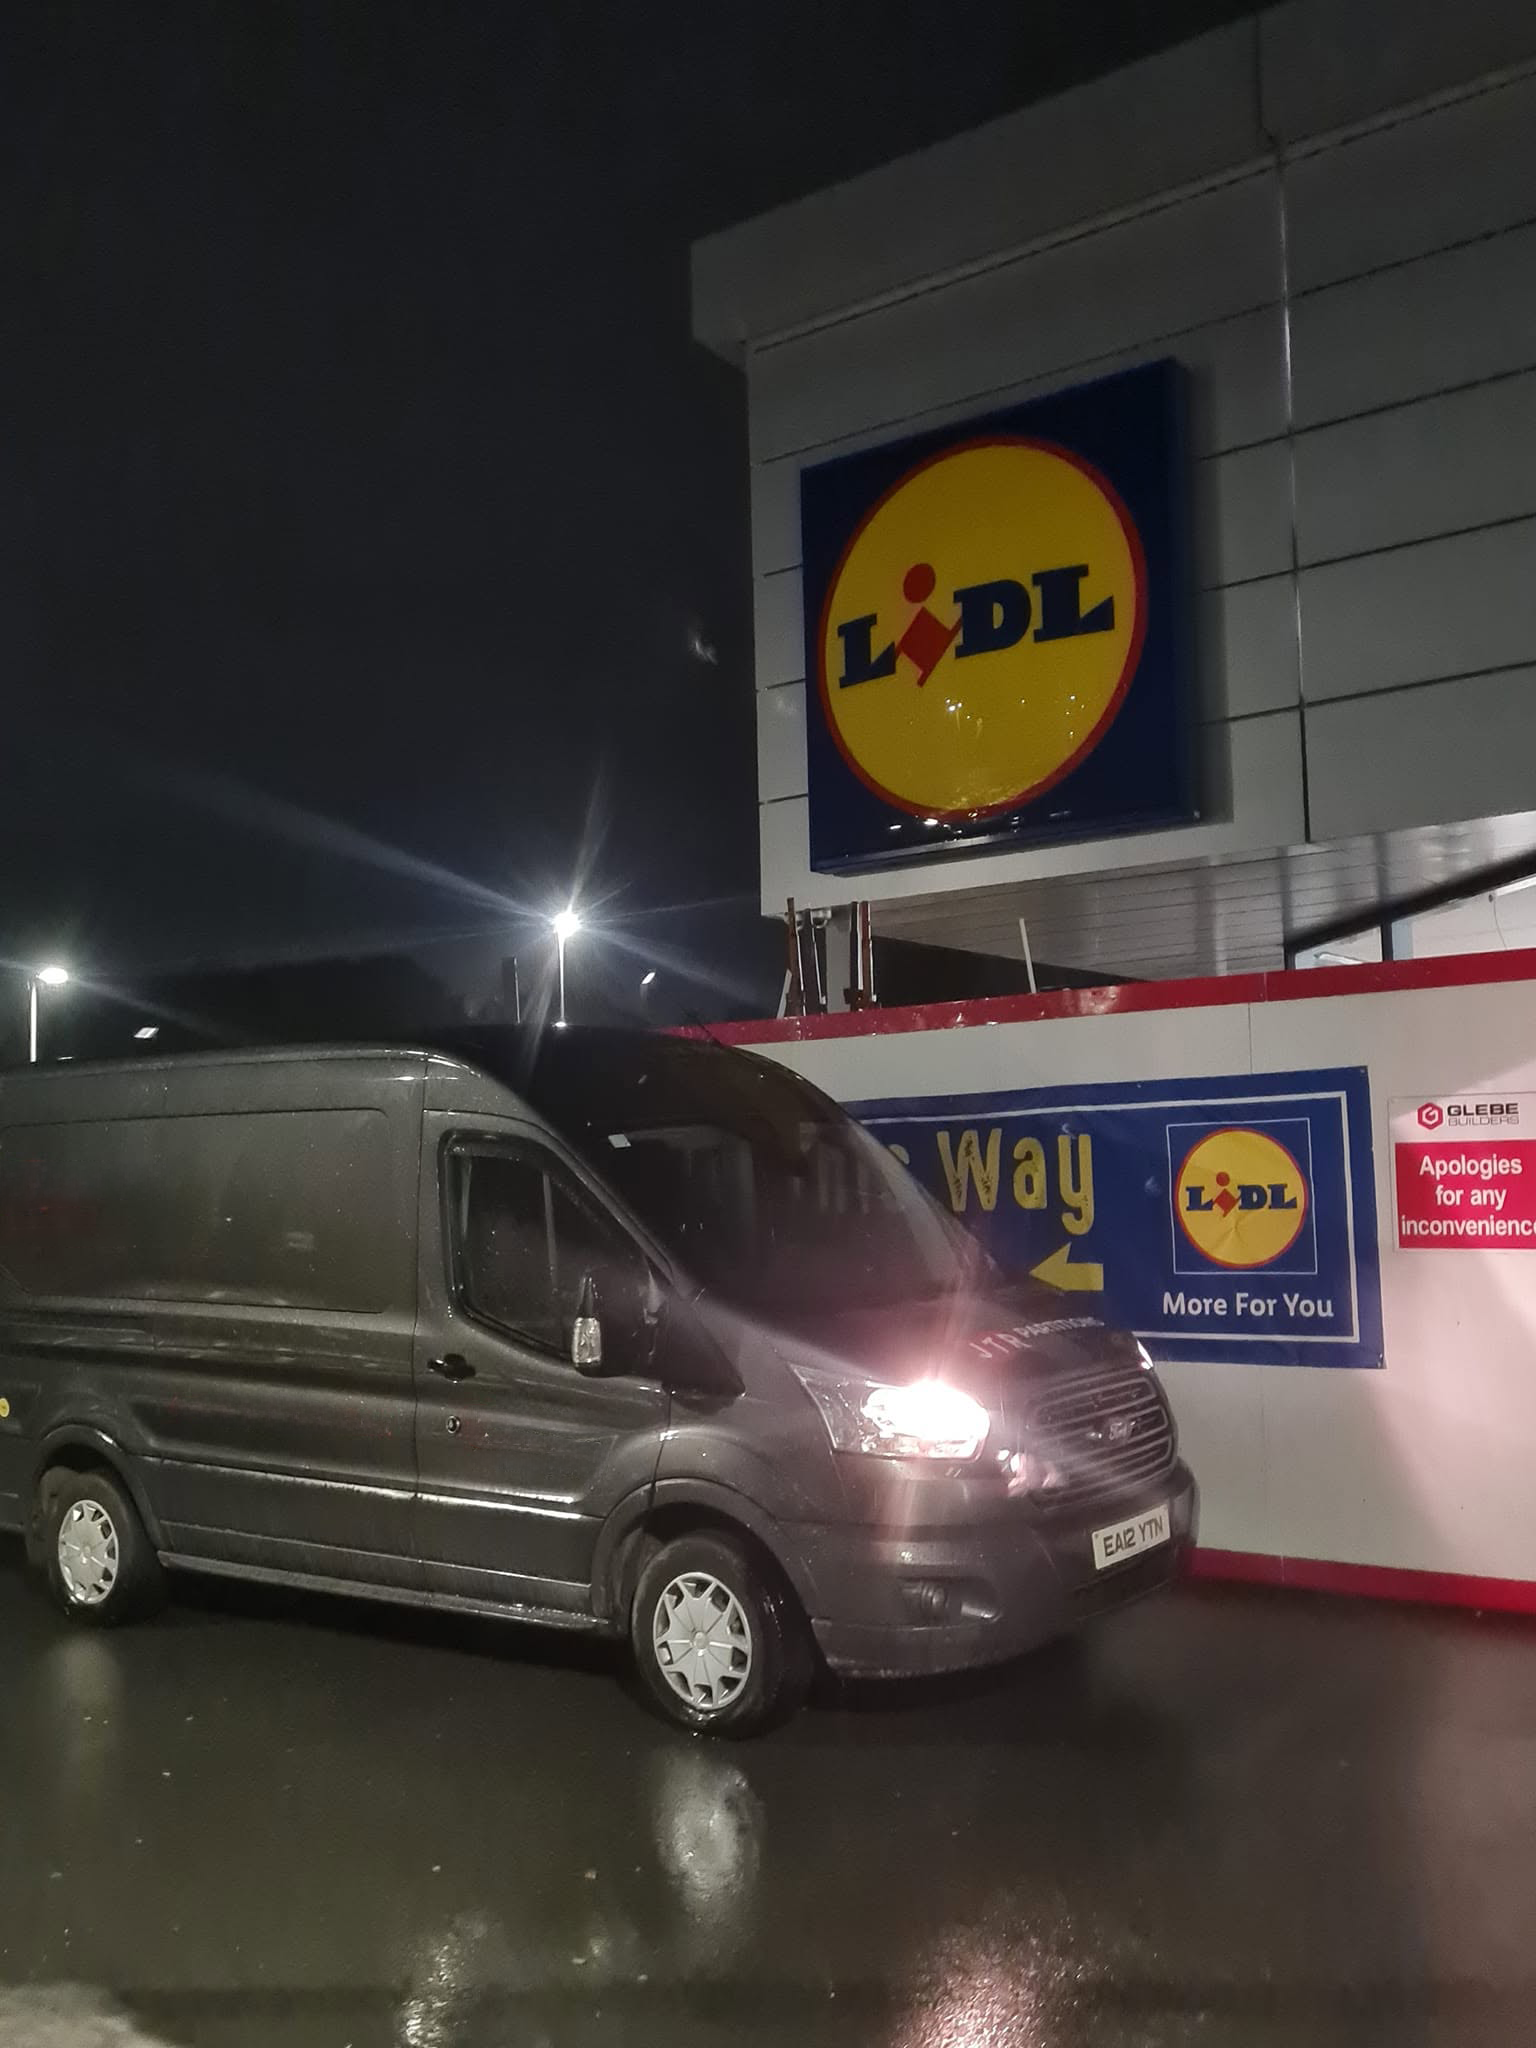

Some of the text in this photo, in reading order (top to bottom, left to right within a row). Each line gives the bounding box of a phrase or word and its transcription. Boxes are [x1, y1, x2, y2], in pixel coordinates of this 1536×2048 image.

[1447, 1103, 1519, 1116] GLEBE
[1448, 1115, 1519, 1126] BUILDERS
[1419, 1153, 1523, 1181] Apologies
[936, 1128, 1095, 1235] Way
[1435, 1184, 1507, 1211] for any
[1163, 1292, 1334, 1318] More For You
[1103, 1515, 1164, 1557] EA12 YTN
